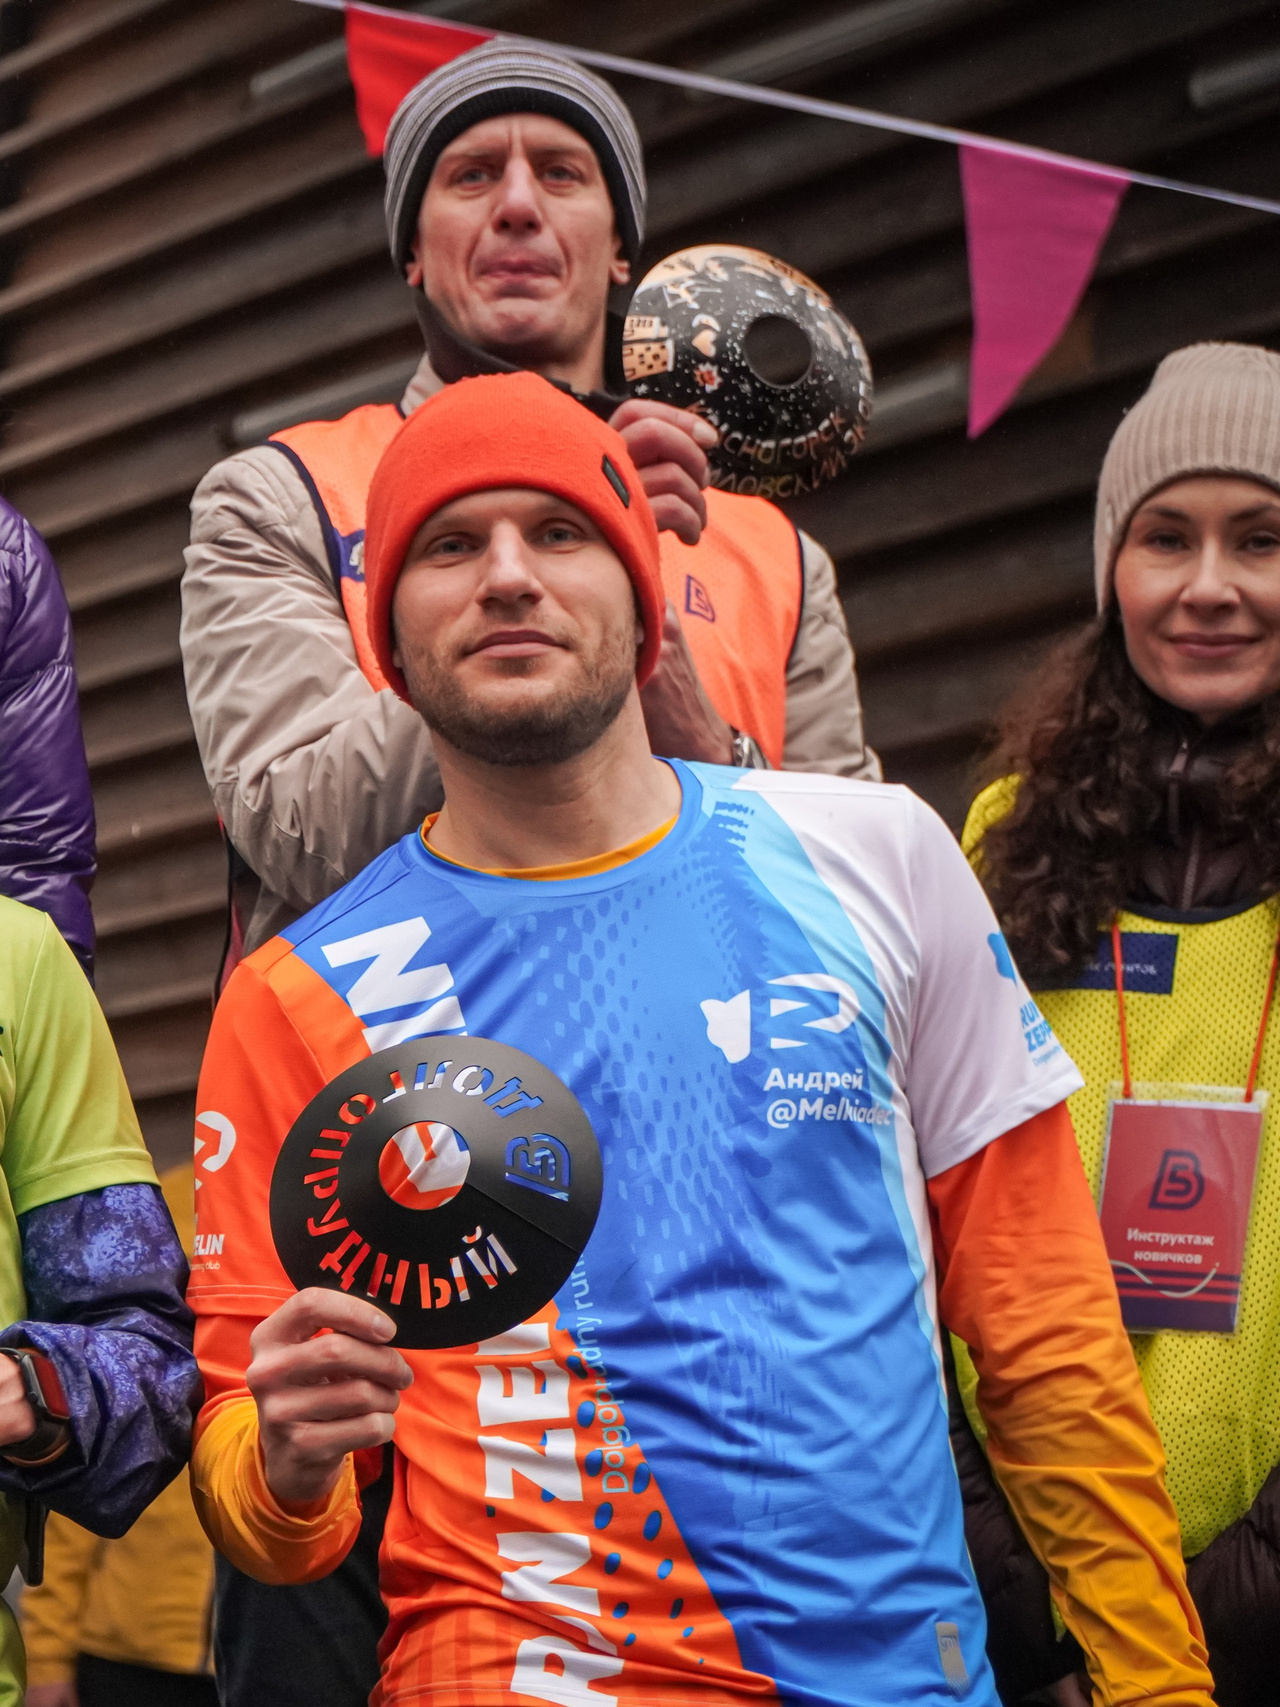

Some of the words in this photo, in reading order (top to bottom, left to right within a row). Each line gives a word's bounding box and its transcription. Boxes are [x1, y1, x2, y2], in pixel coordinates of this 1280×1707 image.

[763, 1067, 863, 1094] Андрей
[304, 1060, 544, 1309] ДОЛГОПРУДНЫЙ
[1126, 1227, 1215, 1247] Инструктаж
[1133, 1248, 1203, 1265] новичков
